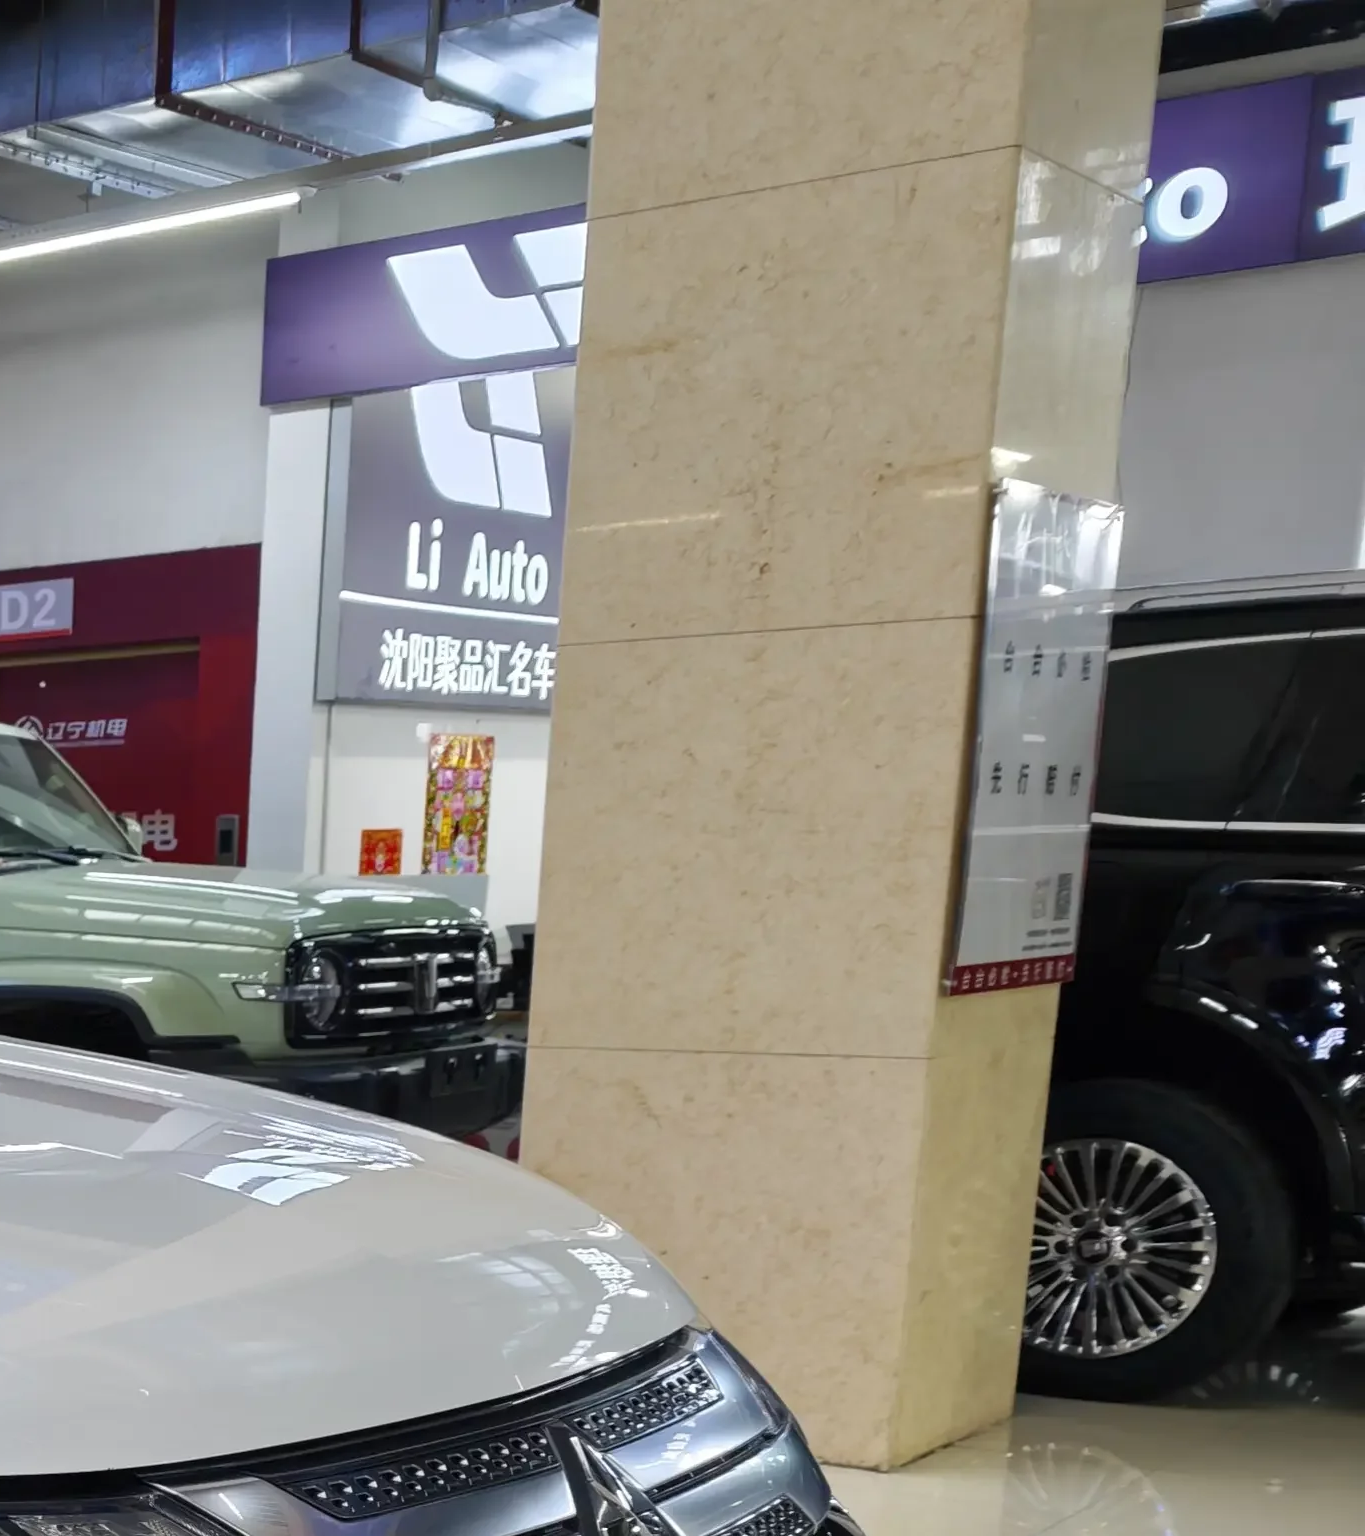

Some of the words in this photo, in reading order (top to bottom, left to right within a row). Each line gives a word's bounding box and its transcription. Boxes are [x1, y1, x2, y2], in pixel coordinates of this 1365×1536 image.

[406, 518, 443, 592] Li
[462, 532, 549, 605] Auto
[1, 588, 57, 631] D2
[379, 628, 557, 700] 沈阳聚品汇名车
[46, 718, 128, 741] 辽宁机电
